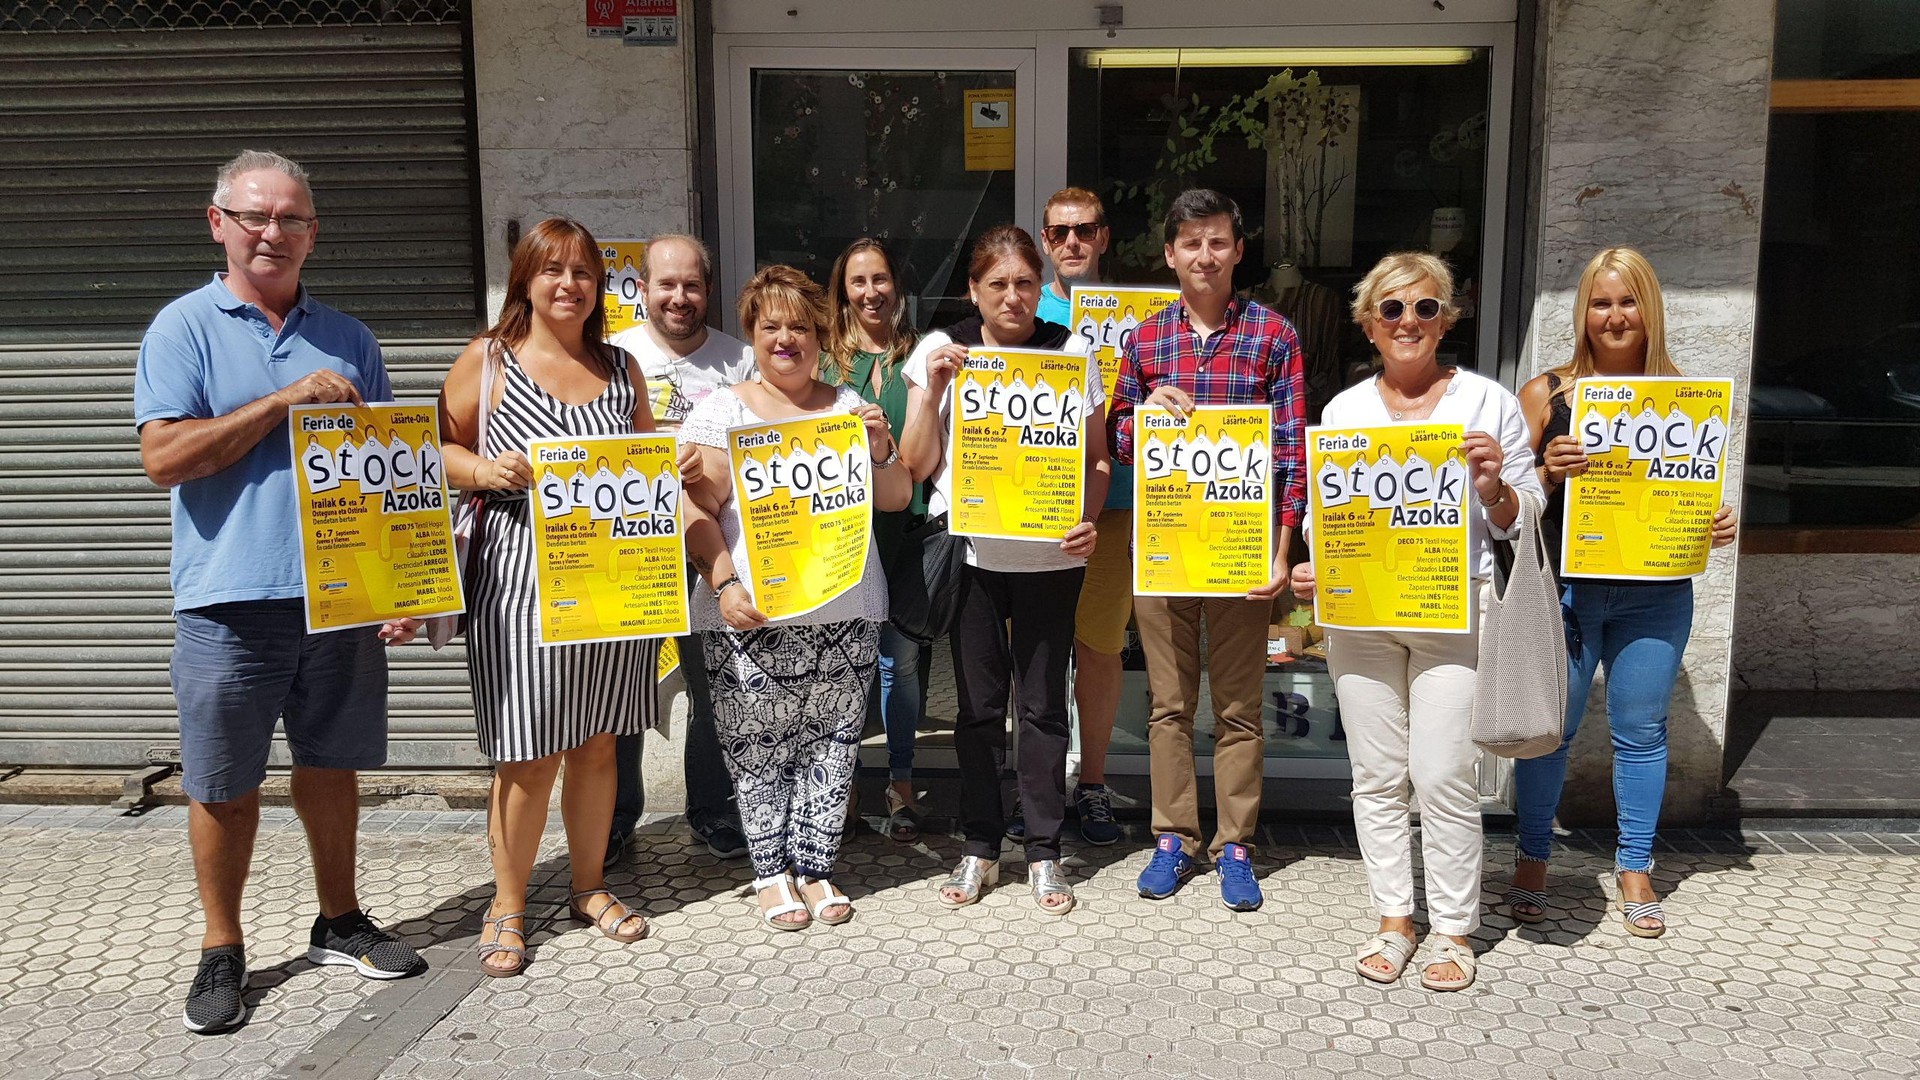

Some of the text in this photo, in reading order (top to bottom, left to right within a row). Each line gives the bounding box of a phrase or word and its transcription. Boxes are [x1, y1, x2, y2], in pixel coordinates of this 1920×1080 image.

[605, 247, 616, 257] de
[1081, 296, 1117, 307] Feria de
[991, 360, 1004, 369] de
[1041, 361, 1080, 371] Lasarte-Oria
[1585, 388, 1631, 399] Feria de
[1675, 389, 1722, 398] Lasarte-Oria
[303, 417, 352, 430] Feria de
[391, 414, 429, 424] Lasarte-Oria
[1146, 416, 1170, 426] Feria
[816, 421, 856, 434] Lasarte-Oria
[962, 426, 982, 434] Irailak
[1001, 428, 1006, 436] 7
[738, 432, 780, 447] Feria de
[1021, 425, 1076, 446] Azoka
[1411, 432, 1456, 442] Lasarte-Oria
[1319, 436, 1366, 450] Feria de
[540, 449, 585, 461] Feria de
[627, 446, 669, 455] Lasarte-Oria
[1648, 458, 1716, 480] Azoka
[1205, 480, 1263, 500] Azoka
[312, 498, 336, 508] Irailak
[338, 497, 346, 506] 6
[359, 496, 366, 505] 7
[383, 487, 442, 512] Azoka
[811, 486, 865, 513] Azoka
[750, 504, 771, 513] Irailak
[772, 502, 779, 510] 6
[1323, 512, 1345, 521] Irailak
[1348, 512, 1354, 520] 6
[1392, 505, 1458, 526] Azoka
[391, 523, 406, 531] DECO
[545, 523, 568, 532] Irailak
[570, 522, 577, 530] 6
[612, 514, 674, 537] Azoka
[1323, 521, 1345, 529] Osteguna
